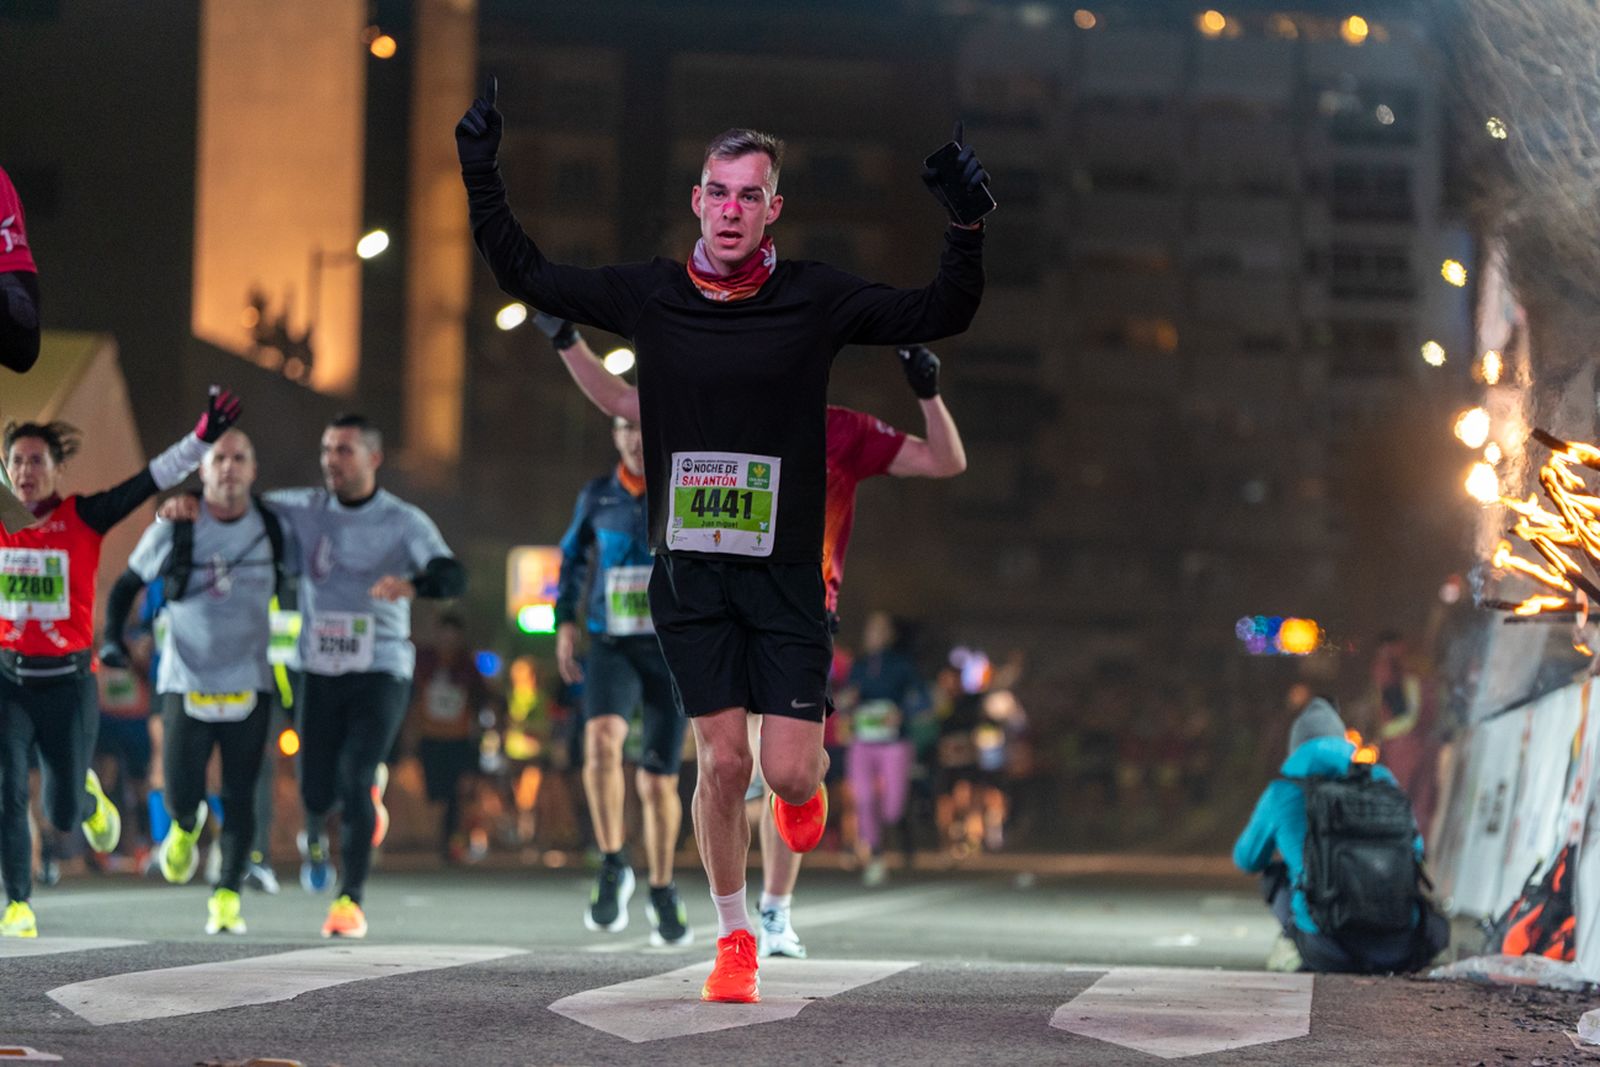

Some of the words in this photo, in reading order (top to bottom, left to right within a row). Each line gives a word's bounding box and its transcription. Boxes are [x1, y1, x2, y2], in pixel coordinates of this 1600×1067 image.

[694, 463, 723, 474] NOCHE
[725, 464, 739, 474] DE
[682, 475, 702, 486] SAN
[703, 474, 737, 487] ANTÓN
[691, 488, 753, 520] 4441
[8, 575, 54, 596] 2280
